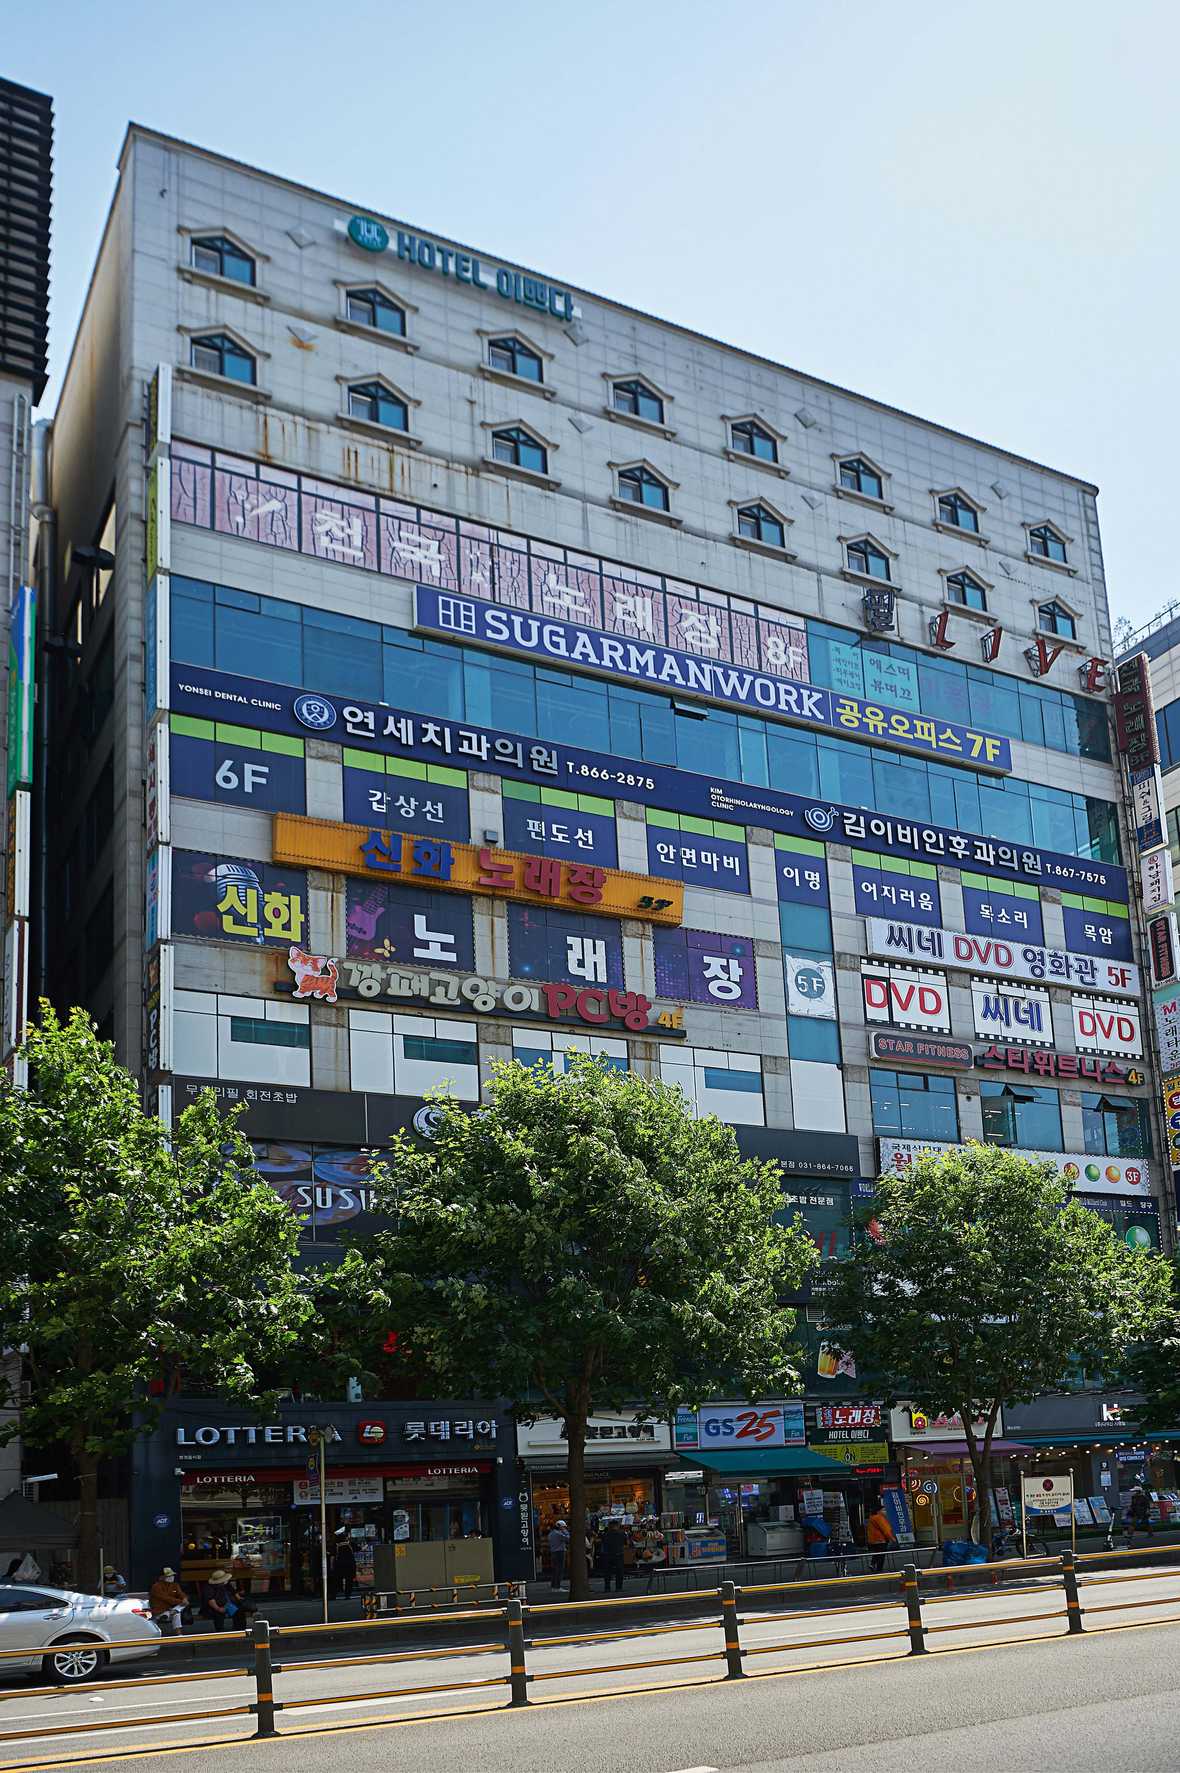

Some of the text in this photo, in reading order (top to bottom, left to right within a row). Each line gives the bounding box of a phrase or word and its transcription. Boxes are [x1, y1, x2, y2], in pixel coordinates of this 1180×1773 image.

[397, 230, 488, 290] HOTEL
[178, 683, 282, 711] YONSEI DENTAL CLINIC
[484, 609, 824, 720] SUGARMANWORK
[836, 698, 963, 752] 공유오피스
[966, 732, 1001, 762] 7F
[343, 705, 655, 790] 연세치과의원 T.866-2875
[215, 760, 269, 793] 6F
[710, 787, 723, 795] KIM
[368, 789, 444, 823] 갑상선
[711, 801, 734, 811] CLINIC
[527, 818, 594, 850] 편도선
[842, 811, 1106, 885] 김이비인후과의원 T.867-7575
[359, 832, 455, 882] 신화
[477, 848, 607, 905] 노래장
[656, 843, 740, 876] 안면마비
[783, 866, 820, 890] 이명
[861, 881, 934, 911] 어지러움
[216, 885, 305, 943] 신화
[980, 904, 1028, 928] 목소리
[1084, 924, 1113, 944] 목암
[887, 924, 1132, 988] 씨네 DVD 영화관 5F
[797, 974, 825, 994] 5F
[864, 979, 943, 1016] DVD
[657, 1011, 683, 1029] 4F
[981, 994, 1043, 1032] 씨네
[1078, 1010, 1135, 1042] DVD
[879, 1038, 915, 1054] STAR
[984, 1045, 1145, 1086] 스타휘트니스 4F
[246, 1089, 298, 1104] 회전초밥
[1125, 1170, 1139, 1182] 3F
[704, 1409, 782, 1442] GS25
[834, 1408, 876, 1425] 노래장
[176, 1419, 498, 1447] LOTTERA 롯데리아
[828, 1430, 850, 1439] HOTEL
[196, 1475, 256, 1484] LOTTERIA
[427, 1466, 479, 1475] LOTTERIA
